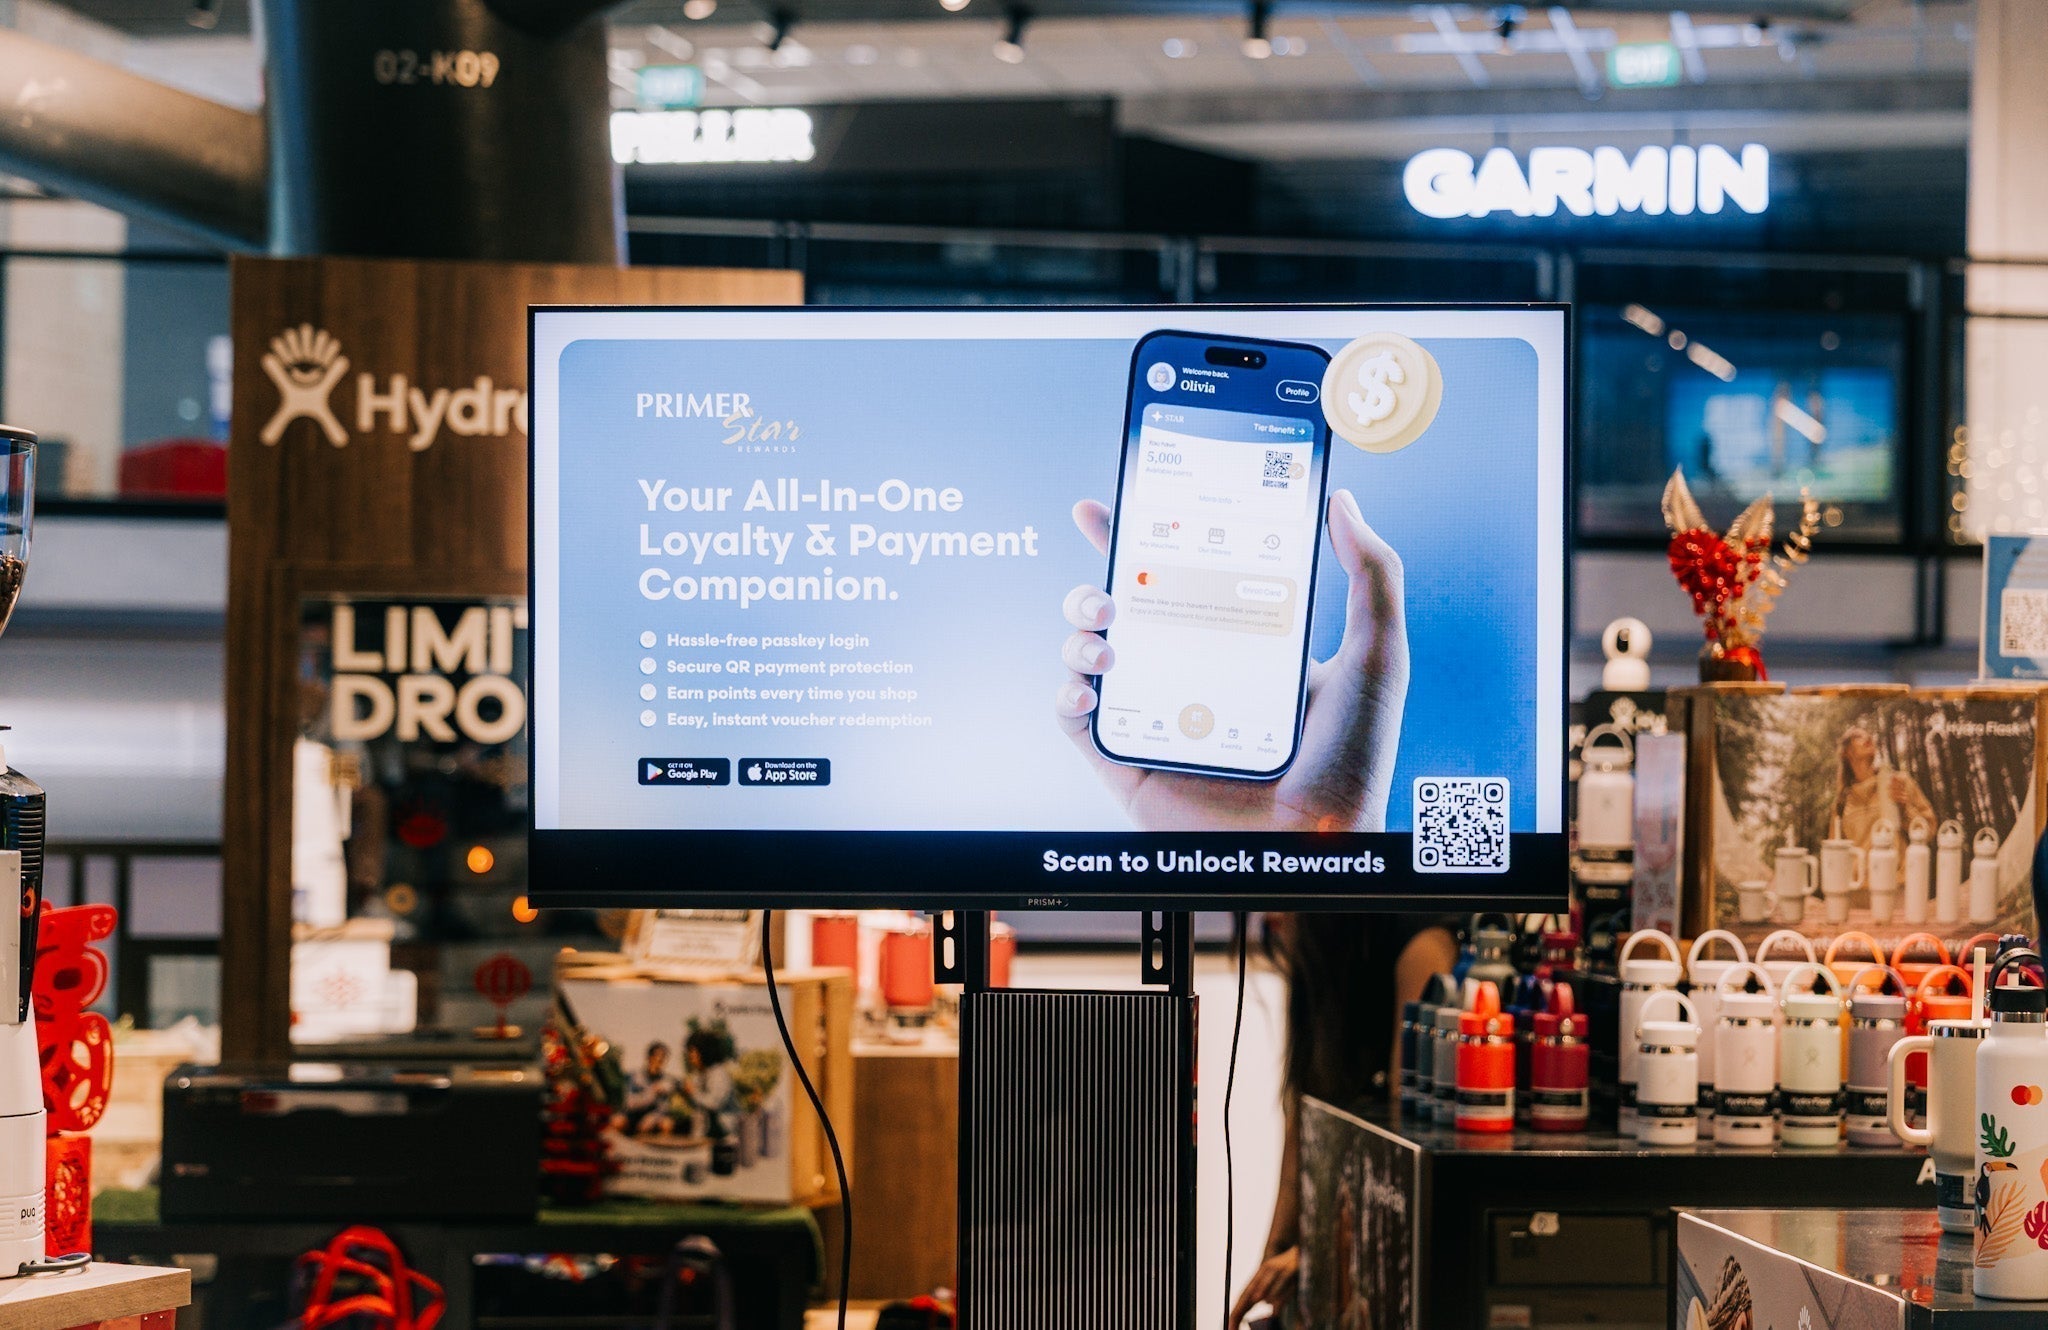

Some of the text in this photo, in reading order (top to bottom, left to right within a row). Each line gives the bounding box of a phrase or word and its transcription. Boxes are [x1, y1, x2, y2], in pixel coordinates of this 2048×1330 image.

[1403, 143, 1769, 218] GARMIN
[1182, 367, 1212, 377] Welcome
[1180, 380, 1216, 394] Olivia
[1285, 387, 1310, 397] Profile
[636, 393, 750, 418] PRIMER
[721, 408, 805, 445] Star
[1165, 415, 1185, 423] STAR
[1254, 423, 1296, 436] Tier Benefit
[1146, 451, 1182, 466] 5,000
[638, 478, 964, 512] Your All-In-One
[640, 522, 1039, 564] Loyalty & Payment
[638, 566, 899, 609] Companion.
[667, 634, 869, 650] Hassle-free passkey login
[667, 661, 914, 676] Secure QR payment protection
[667, 686, 918, 702] Earn points every time you shop
[331, 674, 528, 744] DRO
[667, 712, 932, 728] Easy, instant voucher redemption
[668, 769, 717, 780] Google Play
[765, 770, 818, 782] App Store
[1043, 850, 1385, 873] Scan to Unlock Rewards
[1028, 898, 1062, 906] PRISM+
